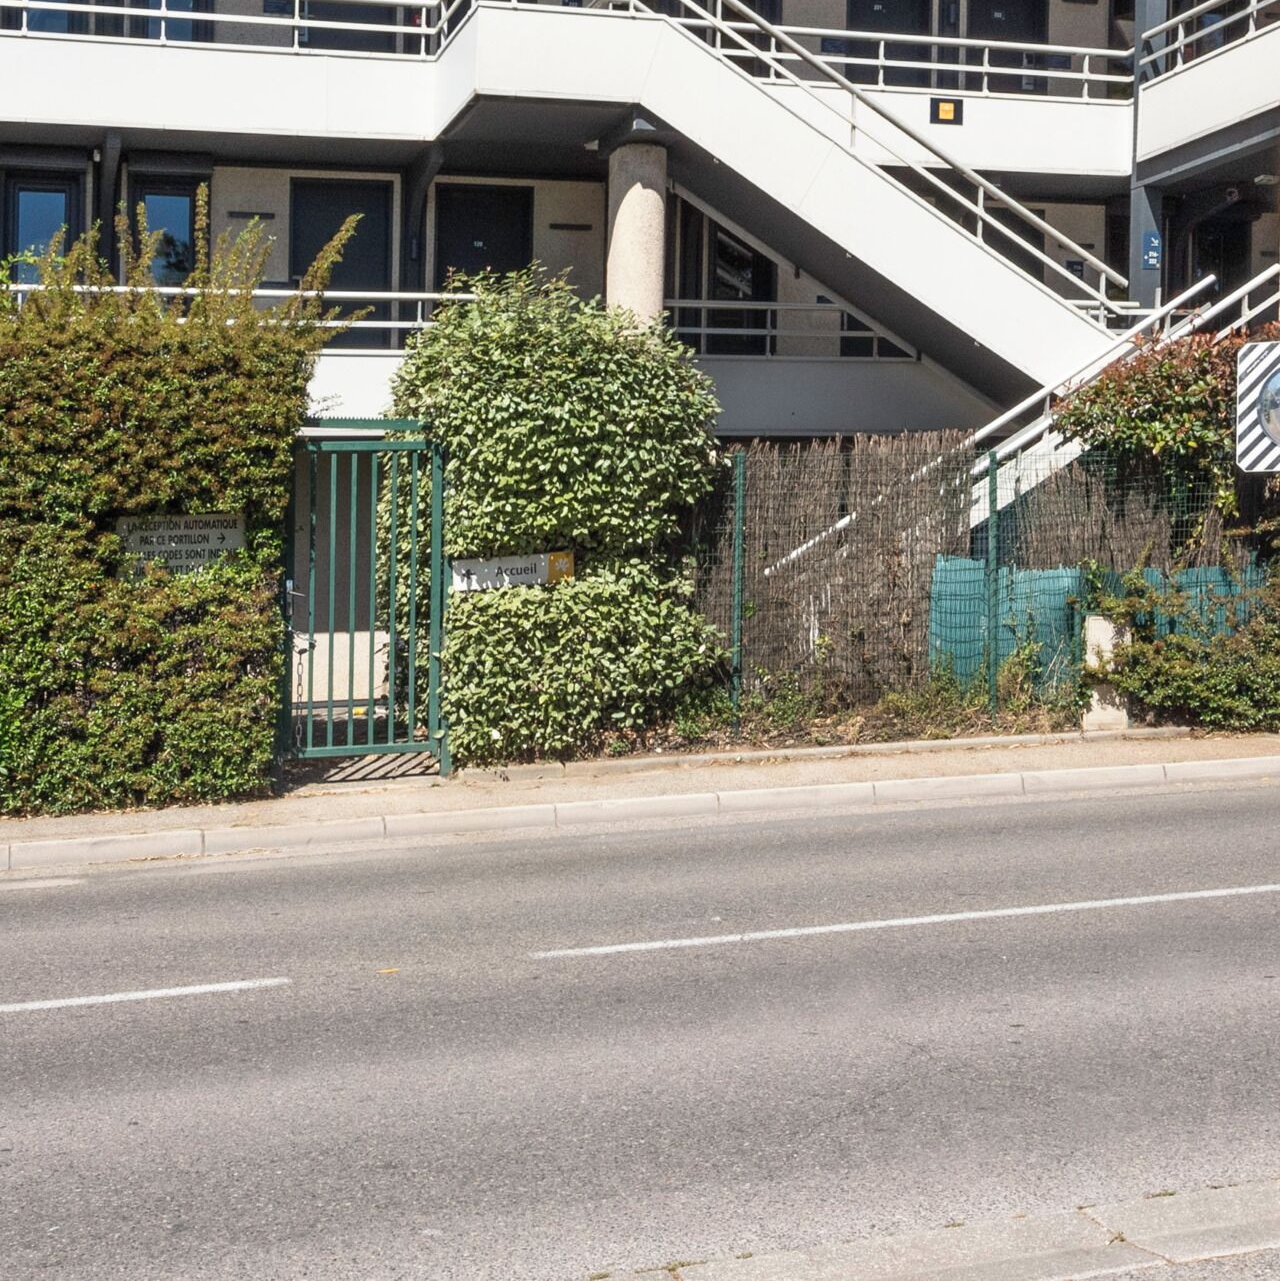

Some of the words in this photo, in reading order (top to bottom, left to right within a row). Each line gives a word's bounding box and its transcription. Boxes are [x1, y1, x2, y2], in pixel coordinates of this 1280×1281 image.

[183, 519, 238, 530] AUTOMATIQUE
[156, 535, 166, 545] CE
[168, 533, 209, 545] PORTILLON
[158, 549, 183, 560] CODES
[185, 549, 205, 559] SONT
[495, 562, 537, 577] Accueil
